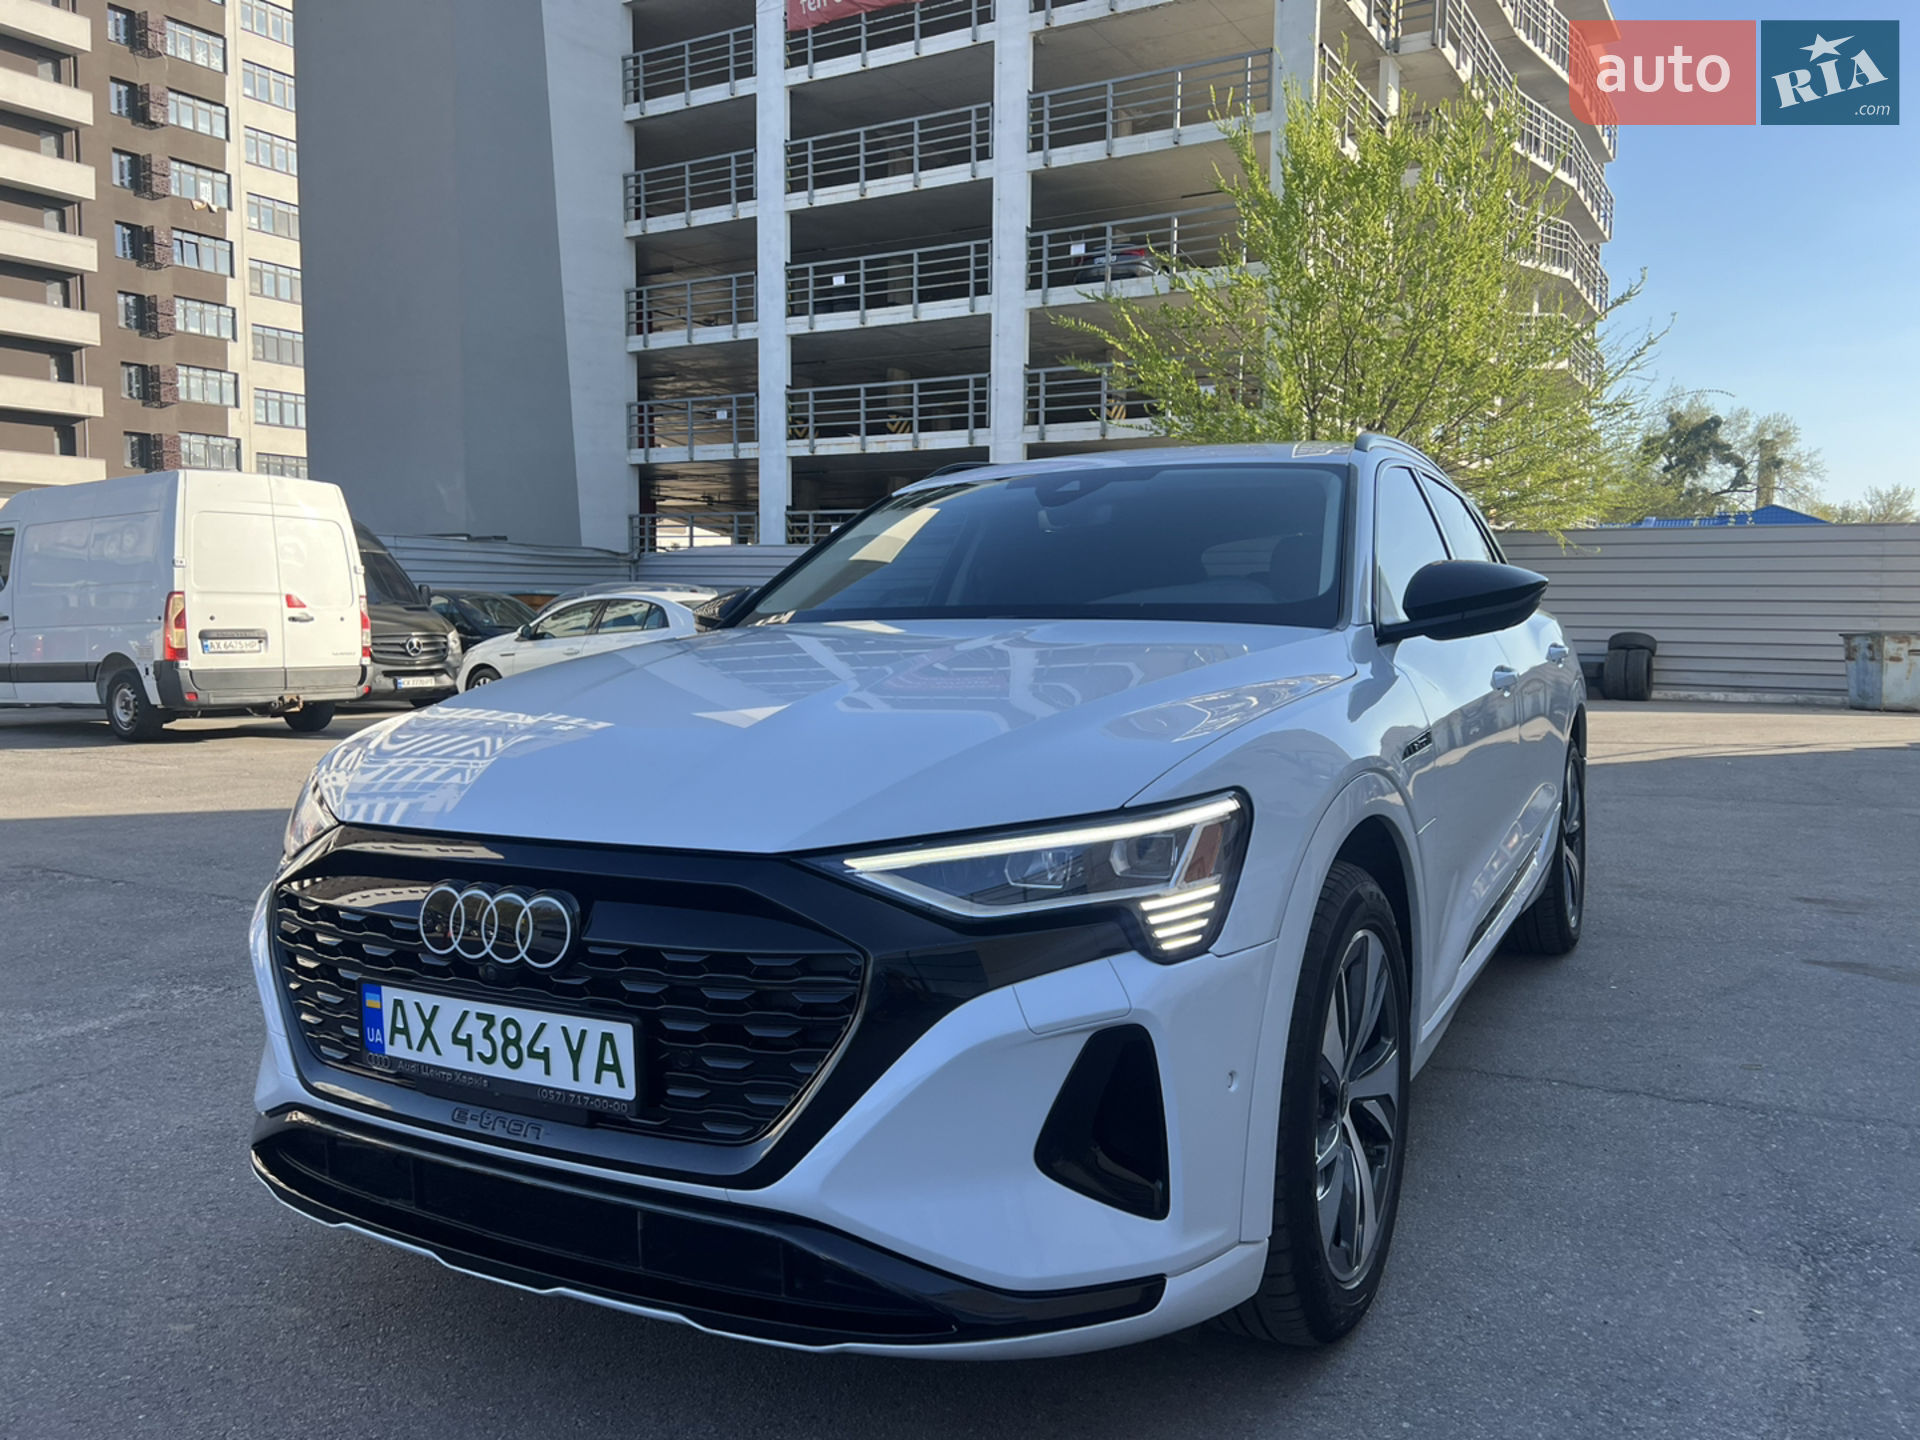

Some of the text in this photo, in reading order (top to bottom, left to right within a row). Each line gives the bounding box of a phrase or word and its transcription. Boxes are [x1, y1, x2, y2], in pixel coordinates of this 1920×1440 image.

[367, 1027, 383, 1044] UA
[388, 998, 626, 1089] AX 4384 YA
[397, 1060, 419, 1073] Audi
[421, 1065, 452, 1081] Центр
[537, 1087, 629, 1113] (057) 717-00-00
